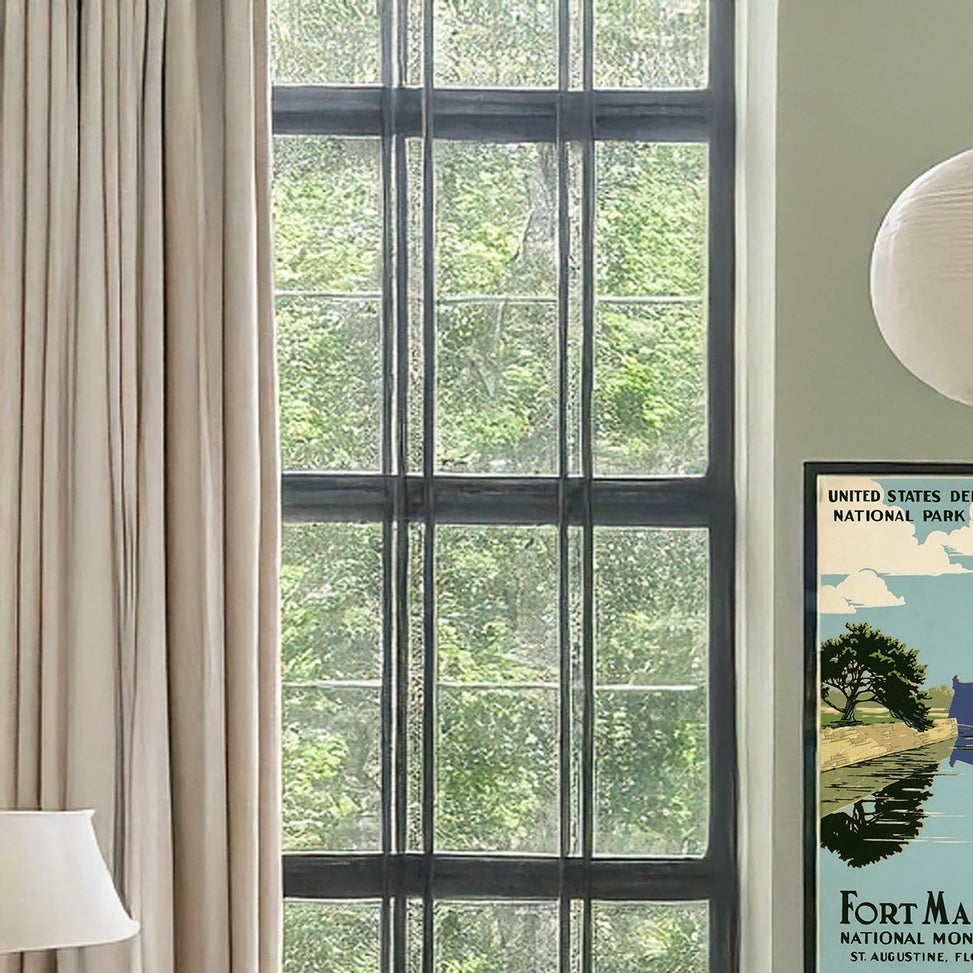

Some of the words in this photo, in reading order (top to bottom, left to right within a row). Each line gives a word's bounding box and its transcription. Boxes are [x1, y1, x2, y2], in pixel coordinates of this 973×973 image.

[828, 489, 881, 503] UNITED
[887, 489, 941, 503] STATES
[833, 509, 914, 522] NATIONAL
[922, 509, 966, 523] PARK
[839, 890, 918, 926] FORT
[840, 931, 926, 946] NATIONAL
[849, 951, 867, 963] ST.
[869, 951, 949, 964] AUGUSTINE,
